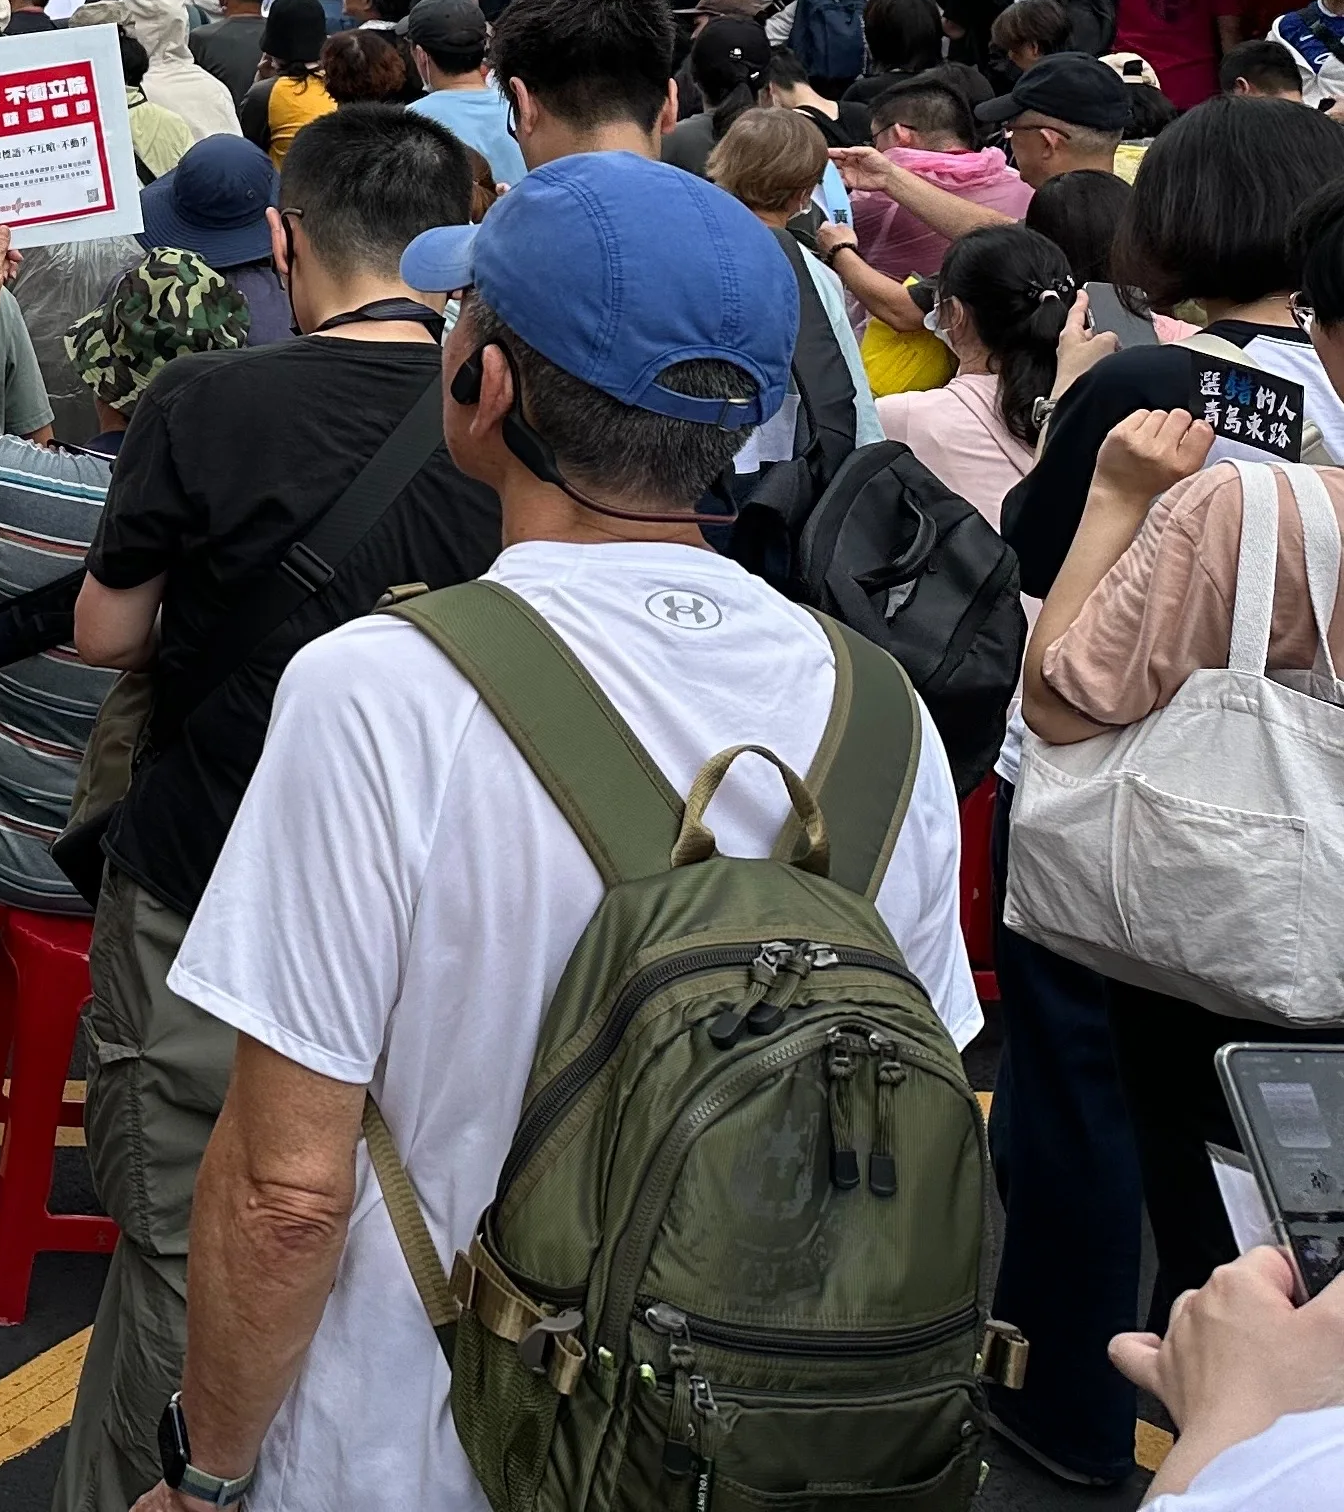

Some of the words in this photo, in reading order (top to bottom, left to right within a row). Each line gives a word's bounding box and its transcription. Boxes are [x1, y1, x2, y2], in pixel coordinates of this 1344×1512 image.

[1199, 369, 1297, 422] 選錯的人
[1203, 399, 1292, 449] 青島東路
